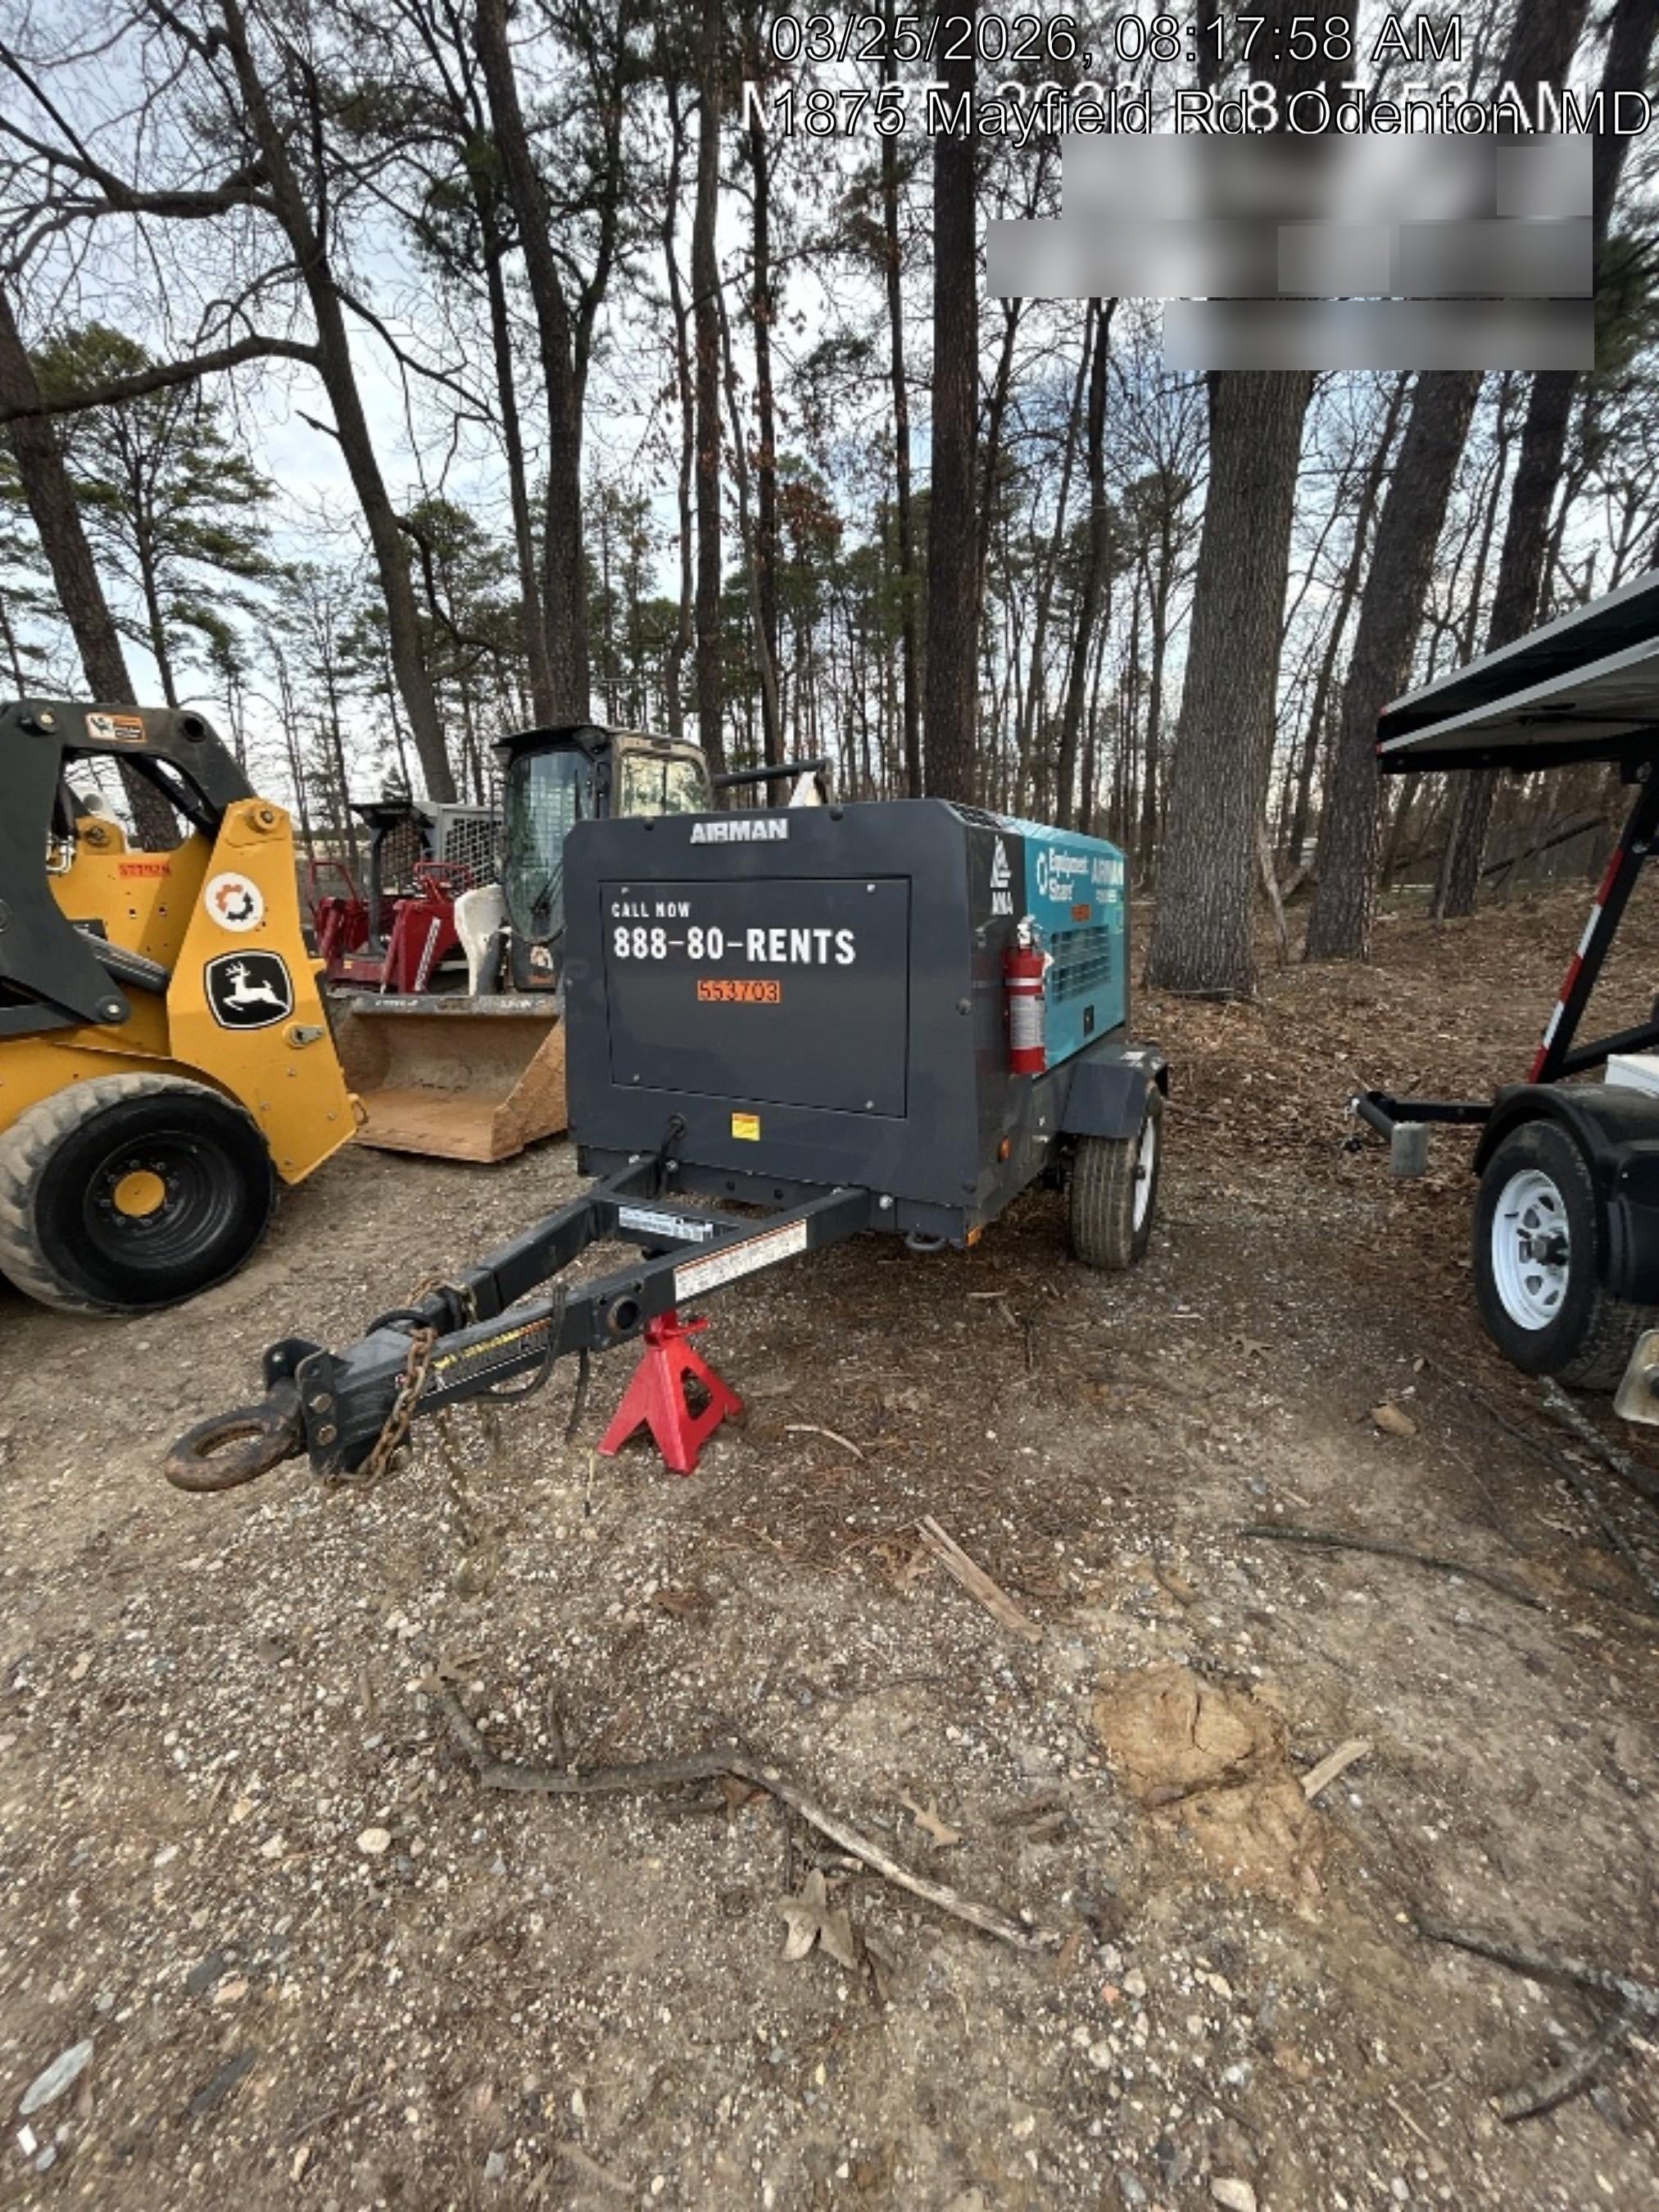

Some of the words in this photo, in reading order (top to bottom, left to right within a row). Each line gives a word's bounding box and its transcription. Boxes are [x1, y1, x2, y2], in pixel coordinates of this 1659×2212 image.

[690, 818, 789, 844] AIRMAN
[611, 902, 650, 918] CALL
[655, 902, 691, 918] NOW
[614, 926, 857, 965] 888-80-RENTS
[699, 982, 778, 1002] 553703
